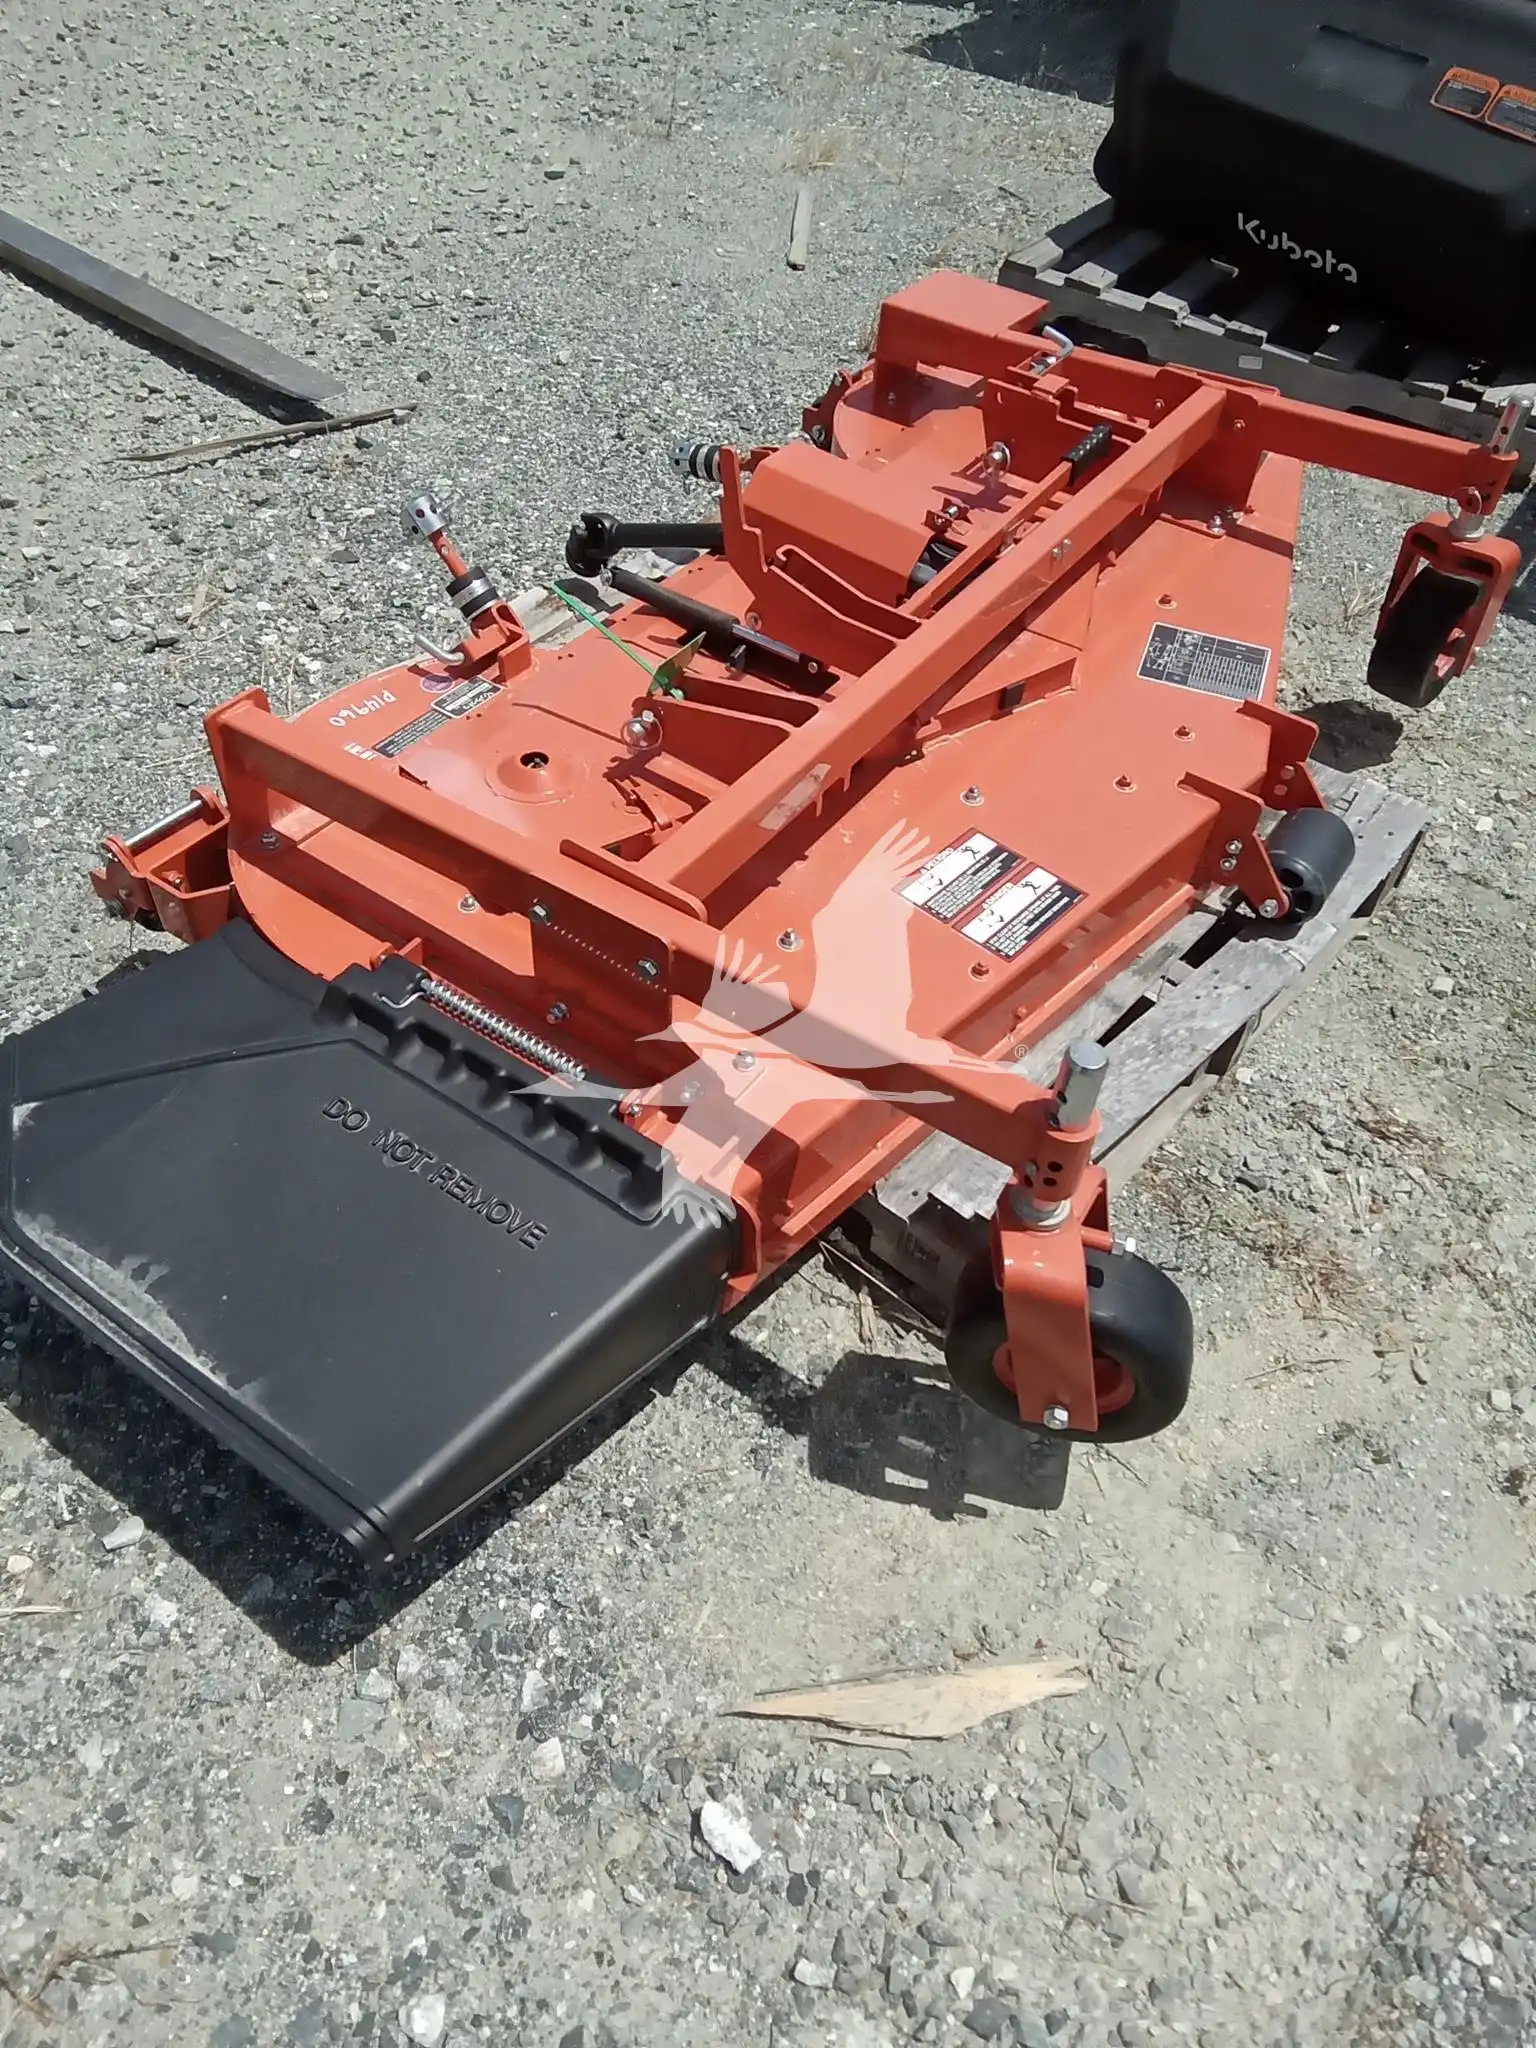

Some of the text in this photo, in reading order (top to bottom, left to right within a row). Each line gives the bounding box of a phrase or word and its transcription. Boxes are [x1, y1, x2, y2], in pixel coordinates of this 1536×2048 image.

[1238, 212, 1357, 283] Kubota
[322, 1097, 549, 1251] DO NOT REMOVE
